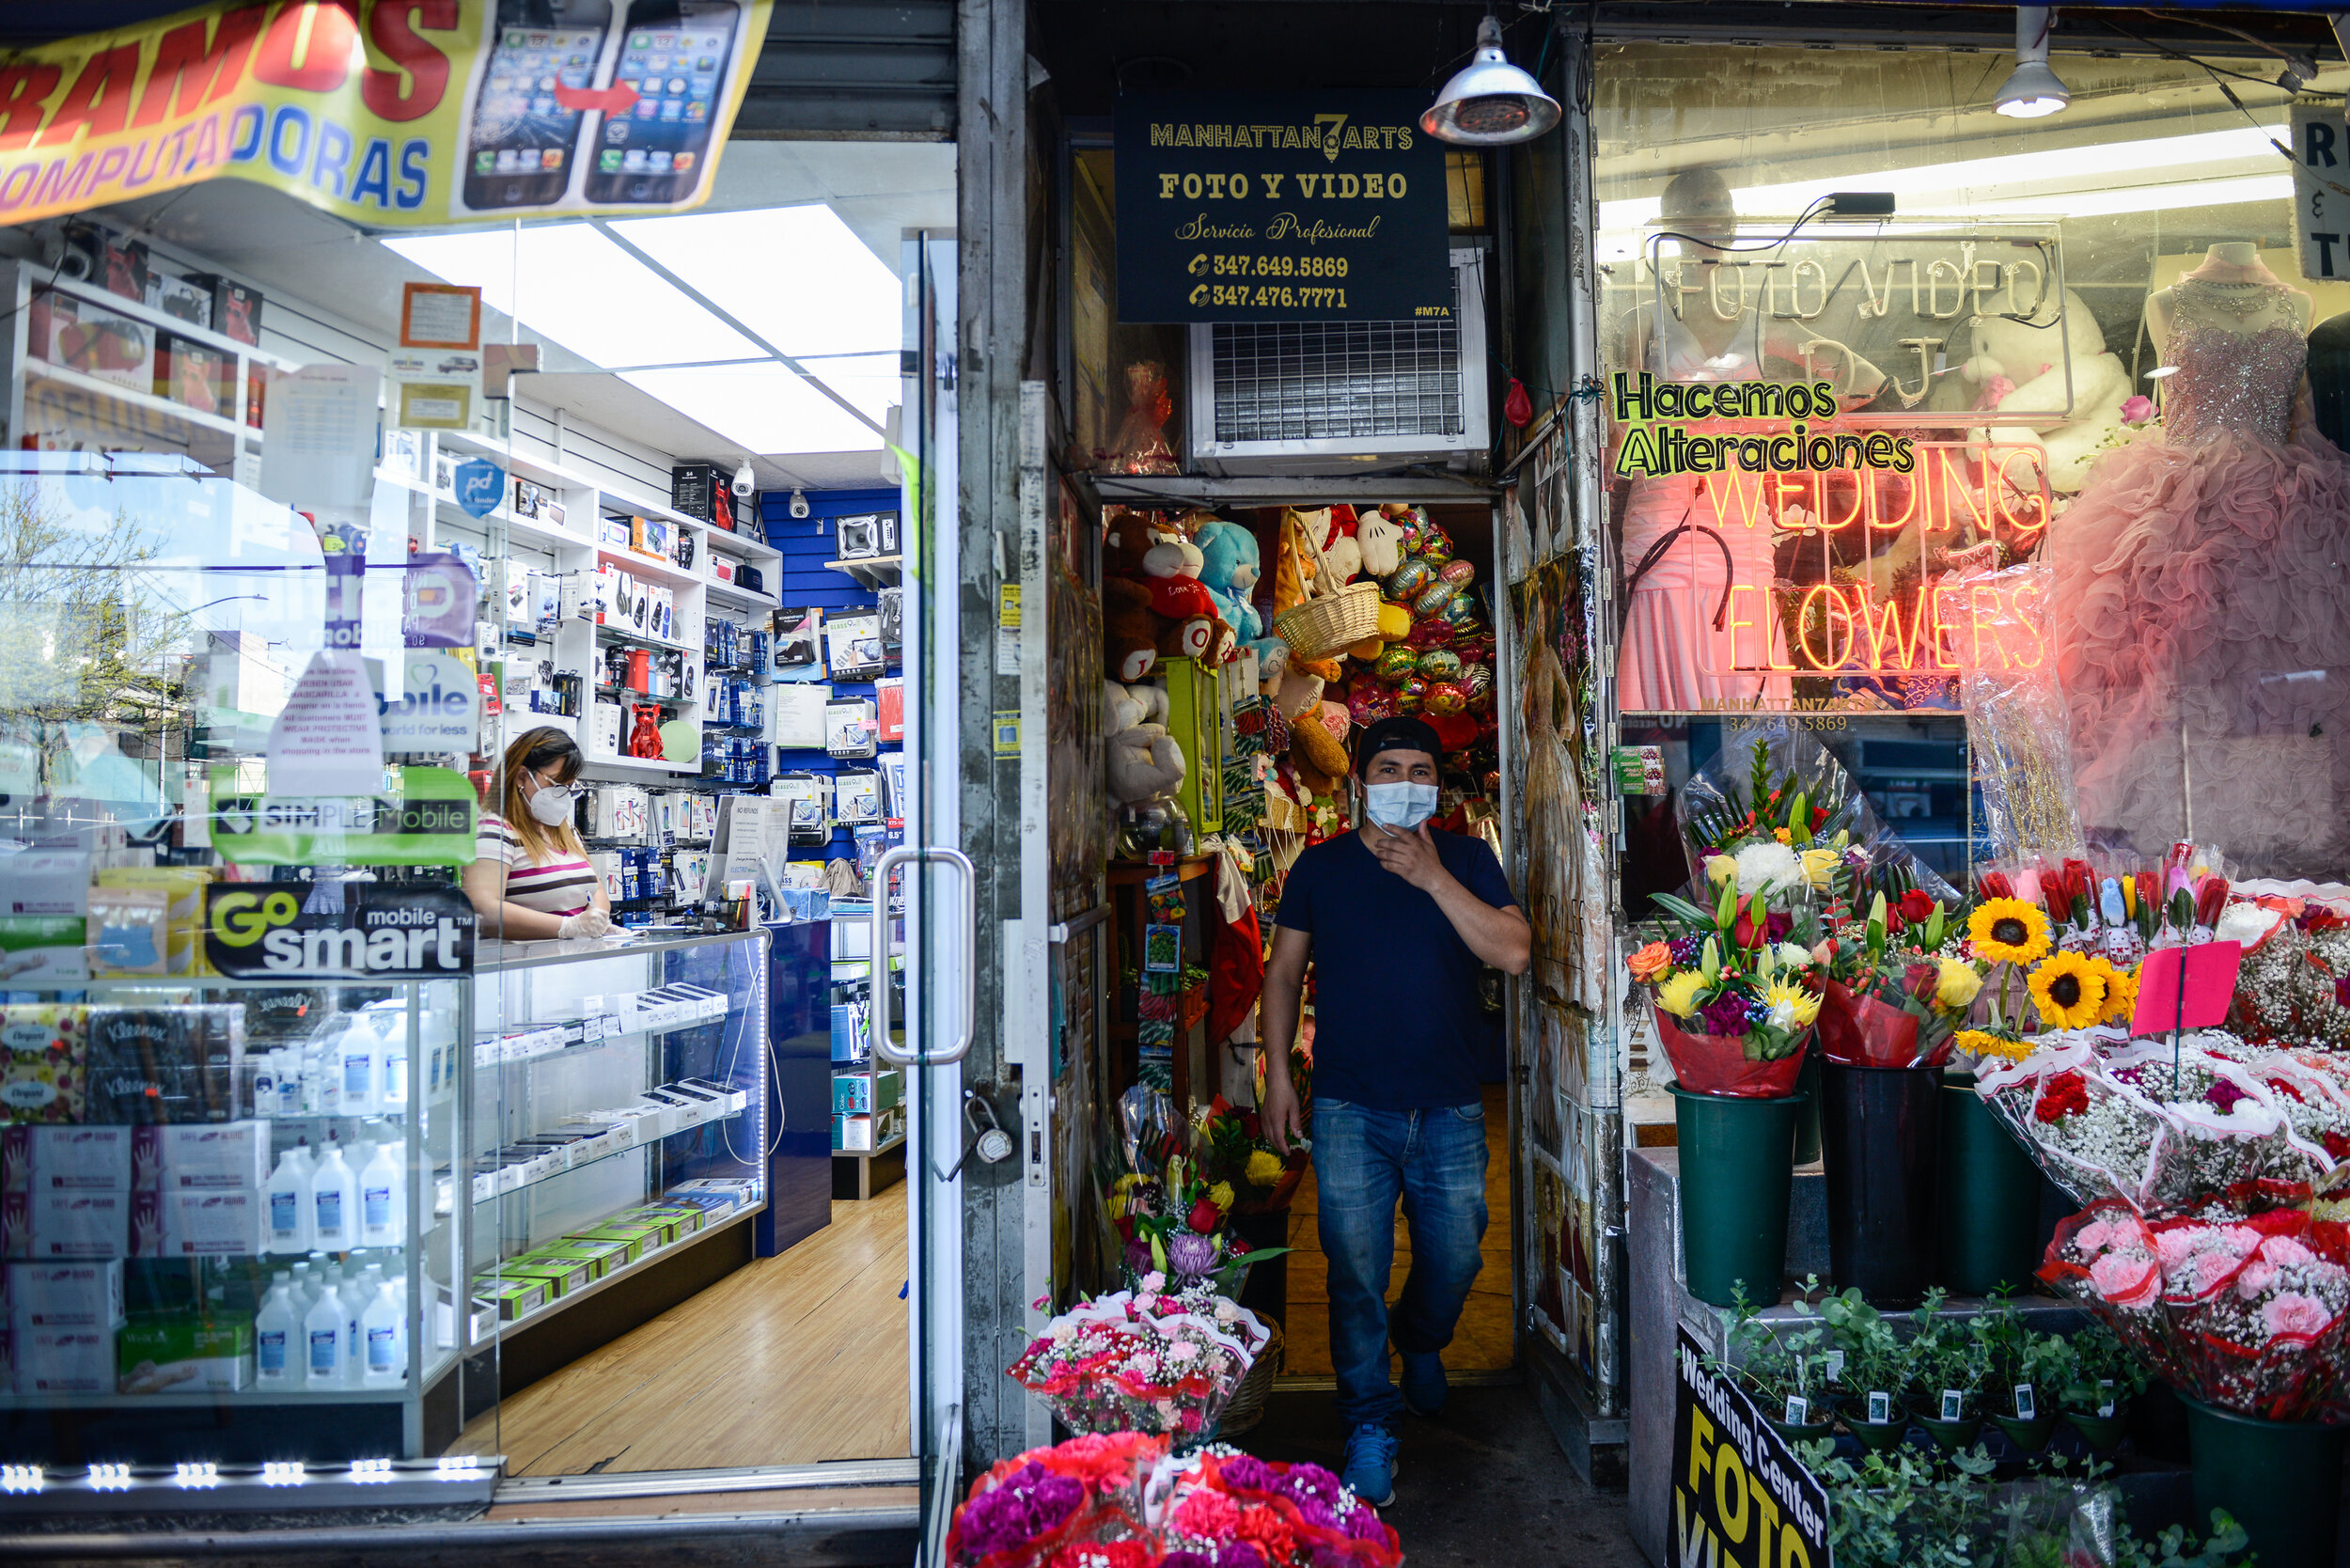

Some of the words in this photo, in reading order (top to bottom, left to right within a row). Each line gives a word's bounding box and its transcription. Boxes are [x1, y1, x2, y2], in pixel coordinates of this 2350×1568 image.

[0, 102, 431, 212] OMPUTADORAS
[2305, 121, 2350, 168] R
[1159, 173, 1249, 199] FOTO
[1261, 173, 1285, 199] Y
[1295, 173, 1408, 199] VIDEO
[1175, 212, 1257, 241] Servicio
[1265, 212, 1382, 245] Profesional
[1213, 254, 1350, 278] 347.649.5869
[1212, 285, 1349, 308] 347.476.7771
[1414, 306, 1450, 318] #M7A
[1616, 372, 1836, 421] Hacemos
[1617, 422, 1916, 478] Alteraciones
[1704, 449, 2048, 531] WEDDING
[1729, 583, 2045, 670] FLOWERS
[418, 723, 438, 736] for
[439, 723, 468, 736] less
[1728, 715, 1848, 732] 347.649.5869
[378, 803, 465, 829] Mobile
[367, 907, 437, 925] mobile
[262, 917, 462, 970] smart
[11, 1030, 46, 1043] Elegant
[105, 1022, 168, 1043] Kleenex
[10, 1088, 45, 1100] Elegant
[1680, 1341, 1754, 1469] Wedding
[1756, 1433, 1825, 1551] Center
